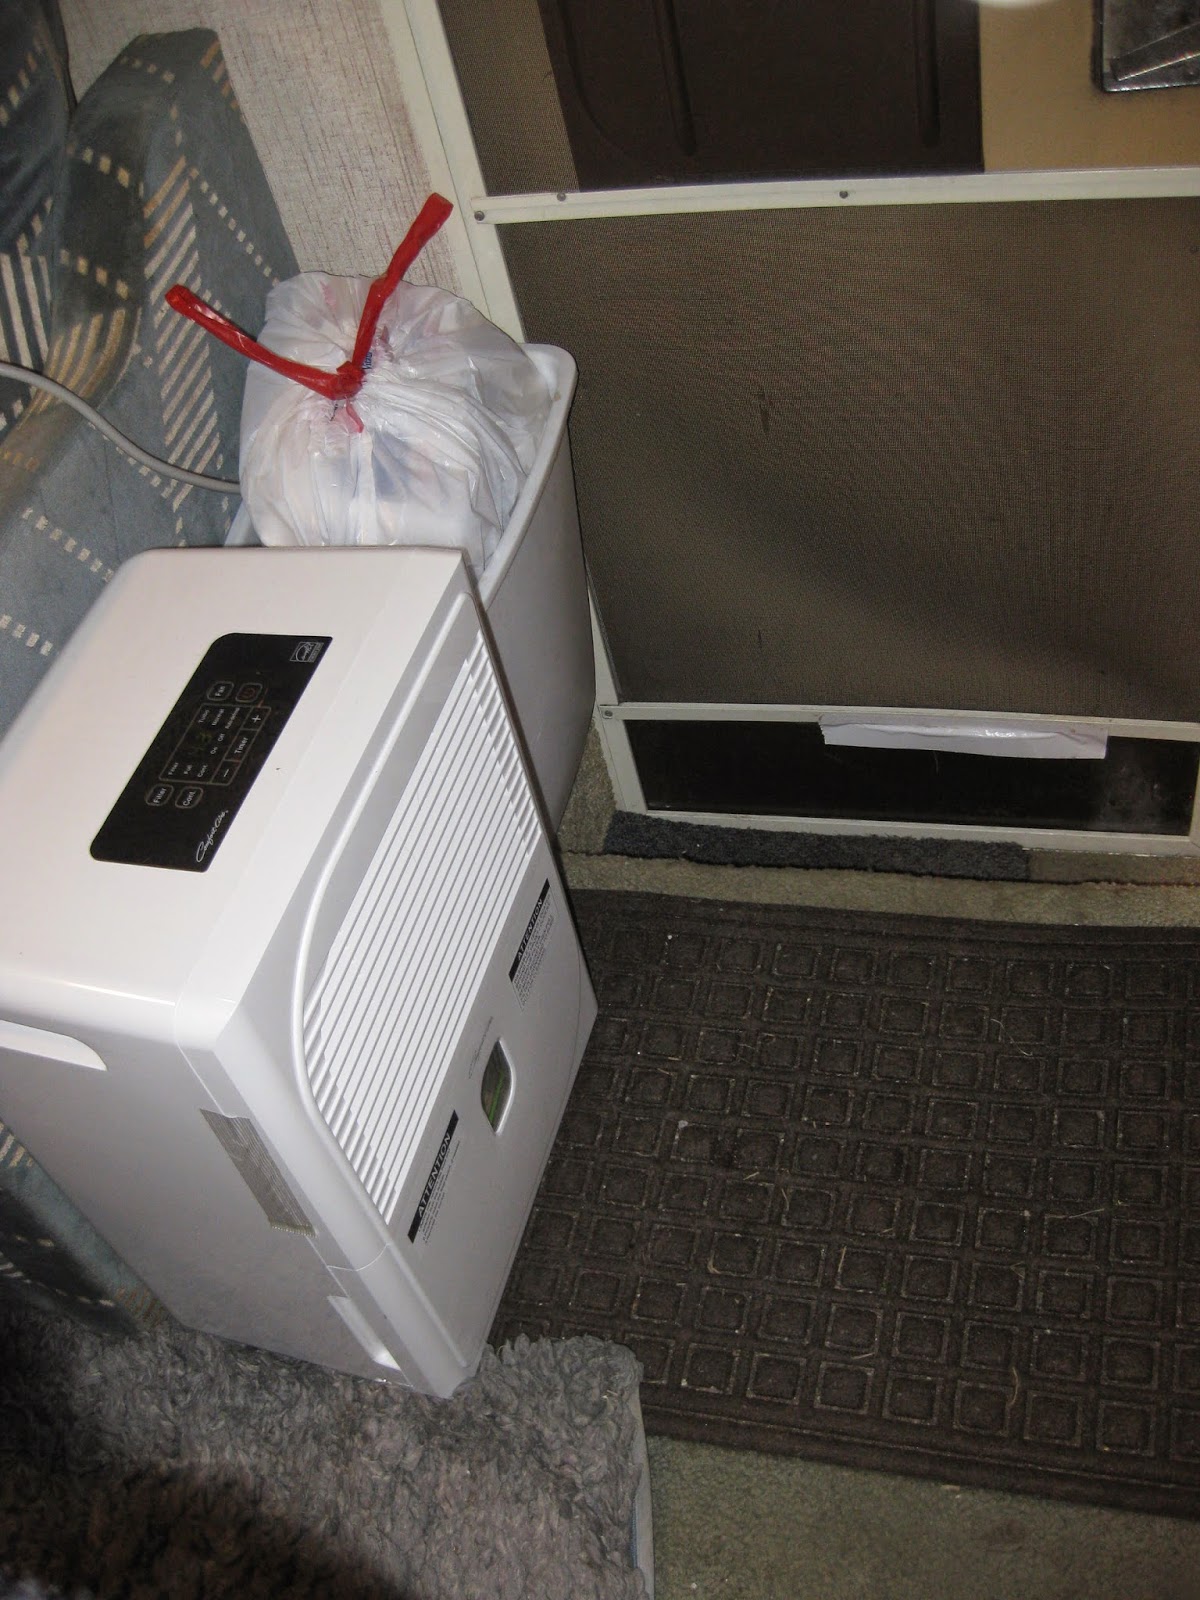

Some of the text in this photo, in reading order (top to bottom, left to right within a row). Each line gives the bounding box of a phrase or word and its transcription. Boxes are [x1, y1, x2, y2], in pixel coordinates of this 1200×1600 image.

[215, 685, 226, 697] Fan
[235, 737, 249, 754] Timer
[153, 788, 167, 804] Filter
[517, 898, 543, 961] ATTENTION
[417, 1132, 451, 1217] ATTENTION
